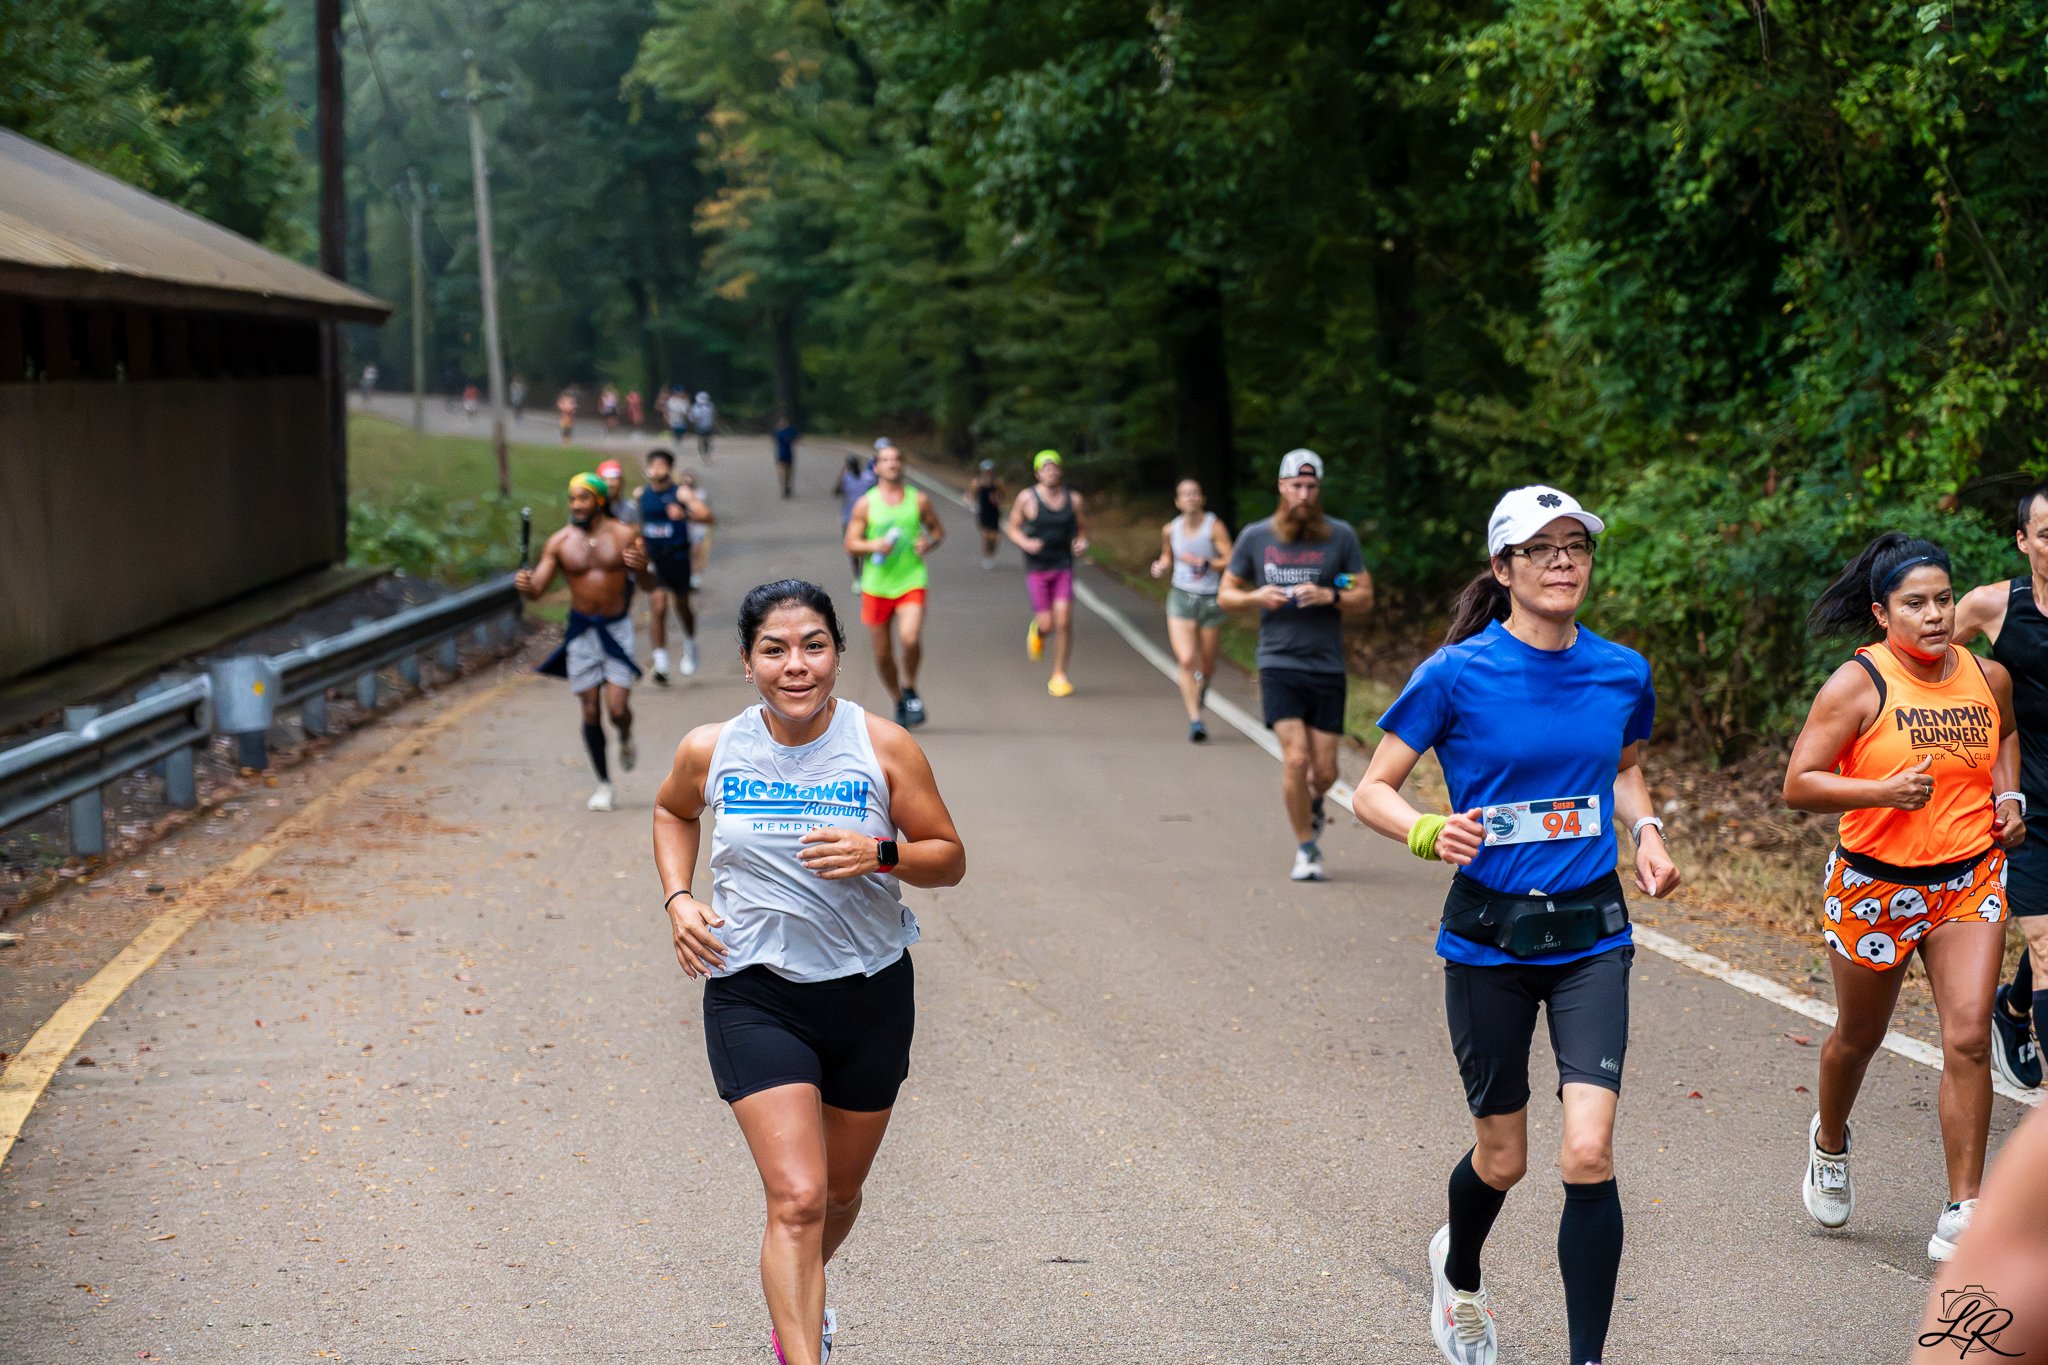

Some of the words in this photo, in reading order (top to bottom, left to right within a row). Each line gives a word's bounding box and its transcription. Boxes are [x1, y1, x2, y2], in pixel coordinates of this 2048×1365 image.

[1895, 706, 1993, 732] MEMPHIS
[1910, 727, 1988, 744] RUNNERS
[1974, 752, 1991, 761] CLUB
[722, 776, 869, 809] Breakaway
[803, 801, 869, 822] Running
[1542, 811, 1582, 839] 94
